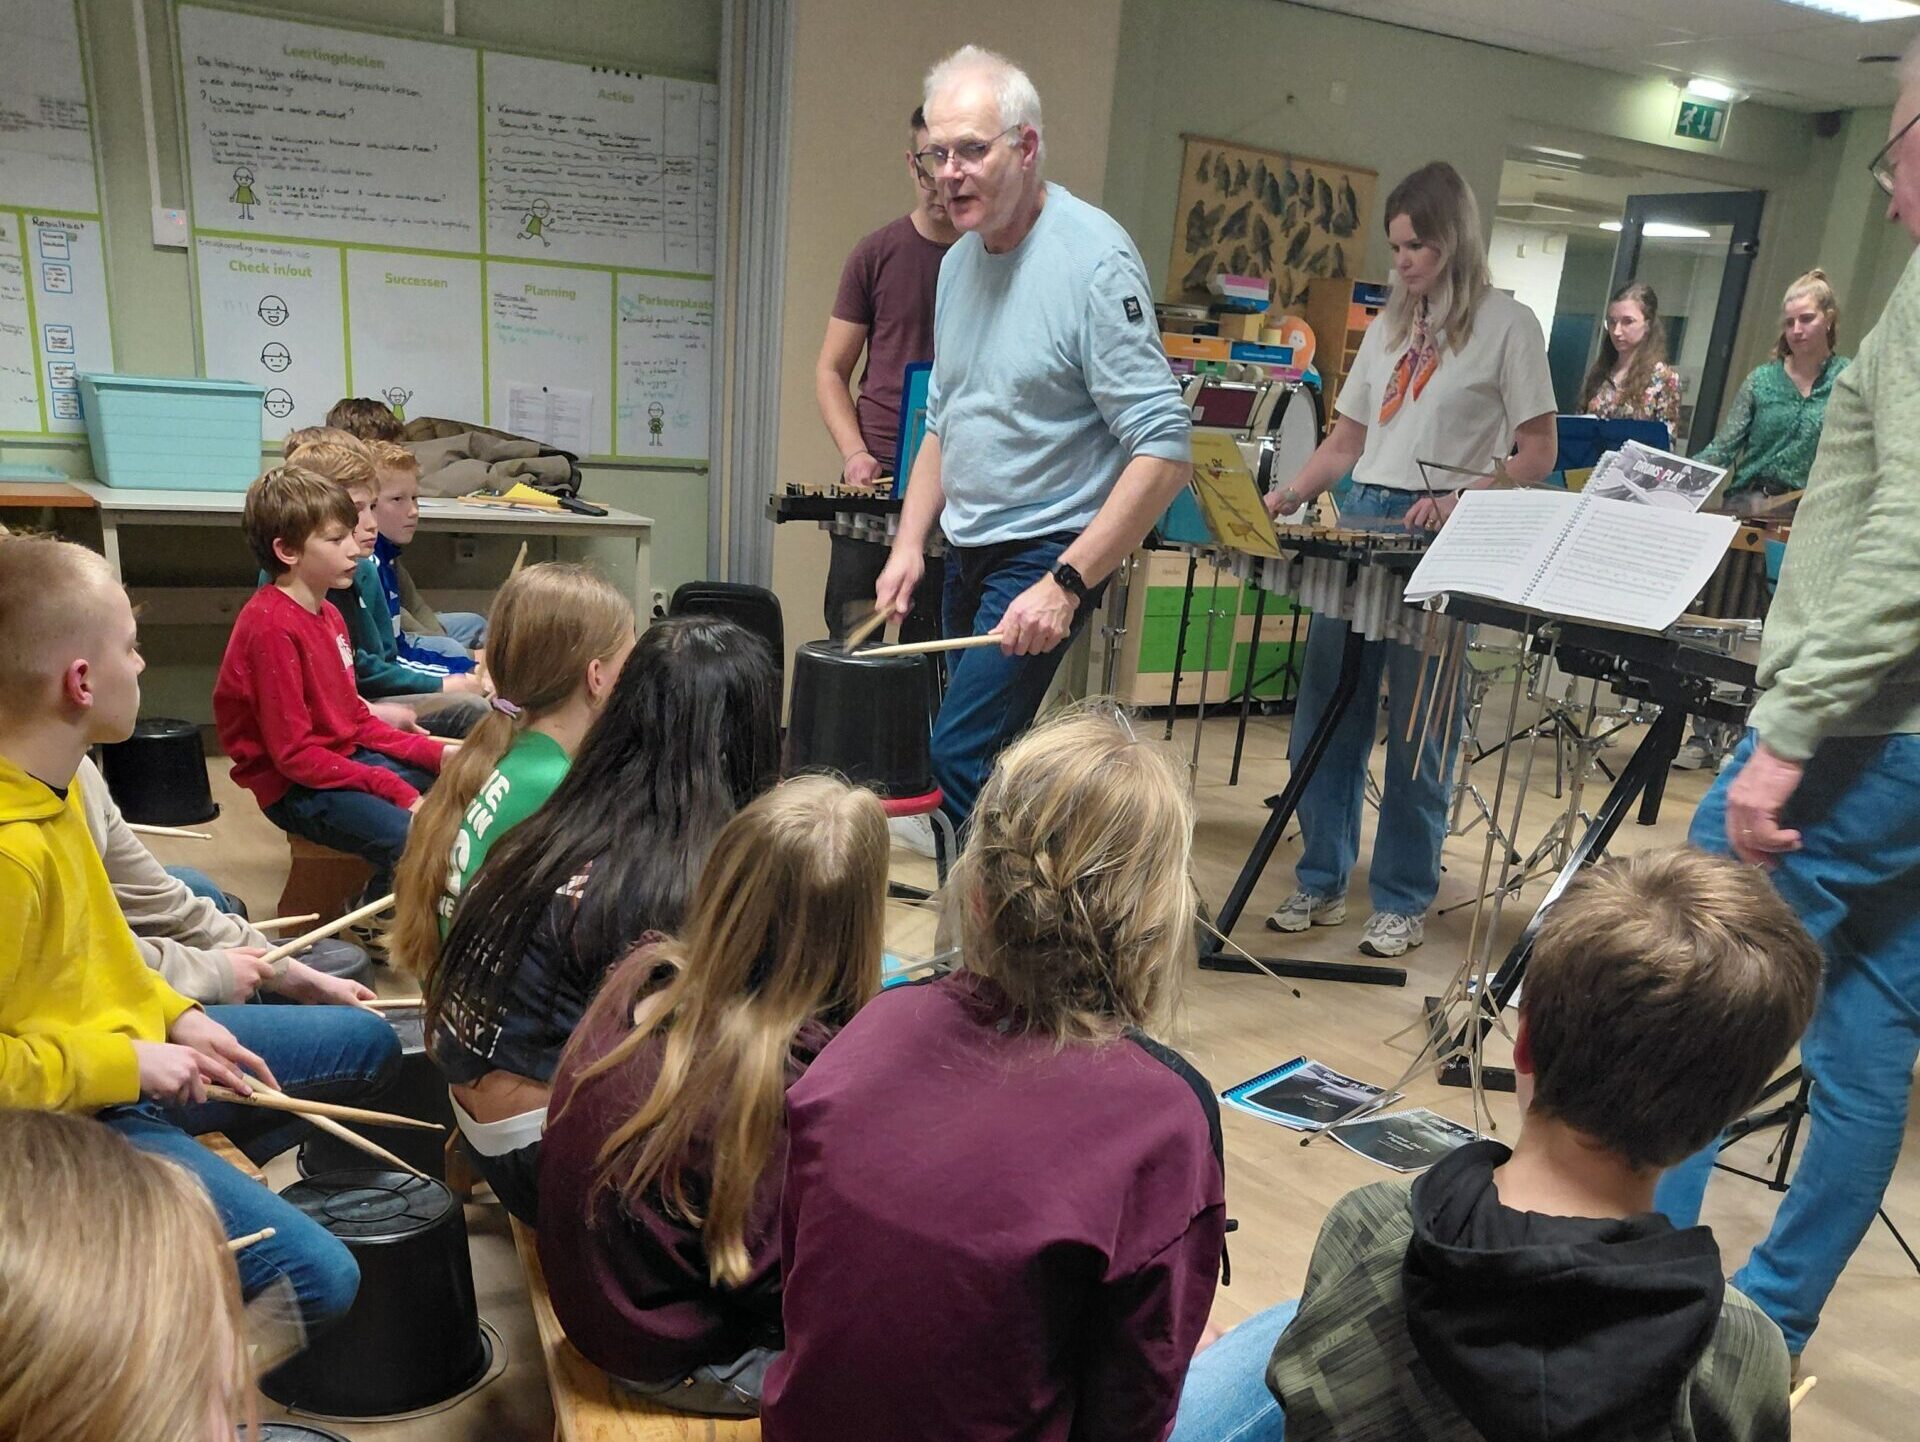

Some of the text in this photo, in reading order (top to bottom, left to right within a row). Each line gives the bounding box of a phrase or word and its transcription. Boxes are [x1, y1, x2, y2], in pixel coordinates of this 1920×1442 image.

[283, 43, 385, 70] Leerlingdoelen
[229, 259, 313, 278] Check in/out
[385, 272, 449, 289] Successen
[524, 284, 577, 301] Planning
